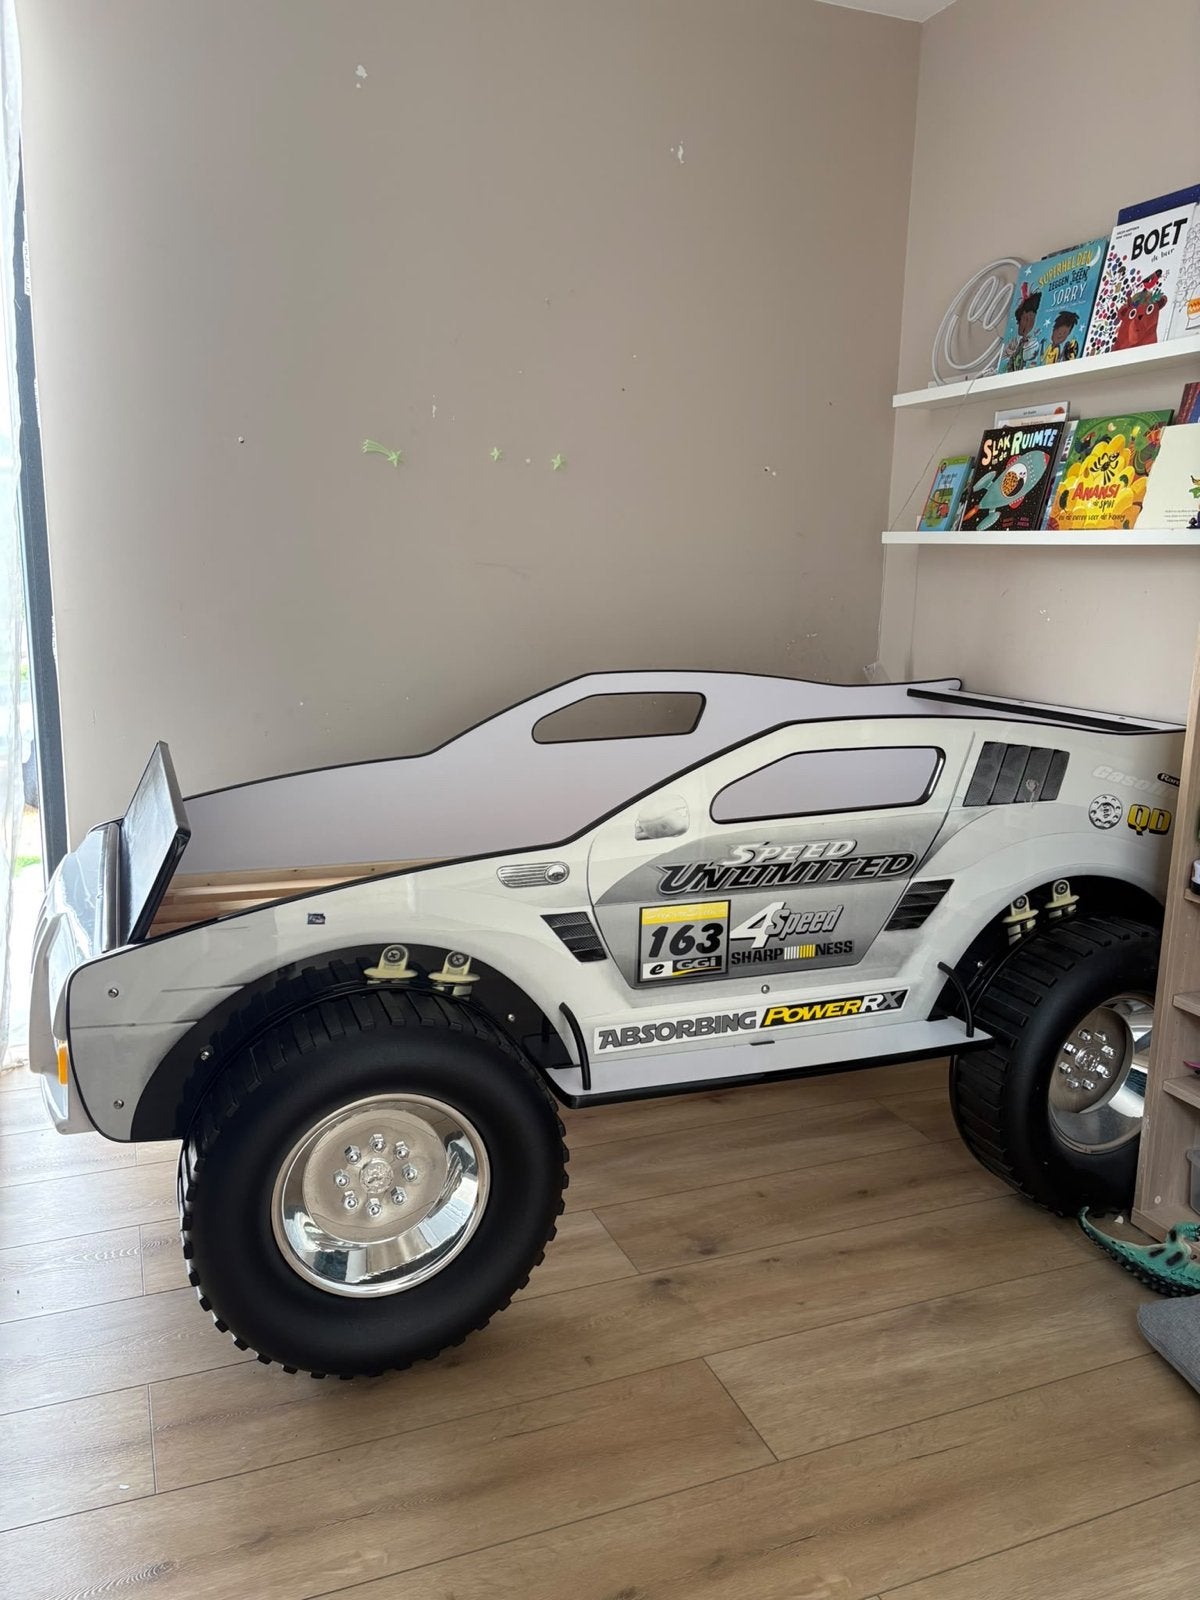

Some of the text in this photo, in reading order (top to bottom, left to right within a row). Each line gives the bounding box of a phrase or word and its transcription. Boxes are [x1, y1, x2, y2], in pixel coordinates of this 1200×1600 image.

[1131, 217, 1188, 261] BOET
[1038, 250, 1093, 288] SUPERHELDEN
[1051, 282, 1087, 306] SORRY
[981, 428, 1058, 466] SLAK RUIMTE
[1072, 482, 1120, 501] ANANSI
[1127, 803, 1172, 836] QD
[722, 839, 857, 866] SPEED
[656, 853, 917, 896] UNLIMITED
[648, 922, 724, 958] 163
[731, 940, 854, 965] SHARP NESS
[649, 963, 665, 976] e
[598, 1011, 757, 1050] ABSORBING
